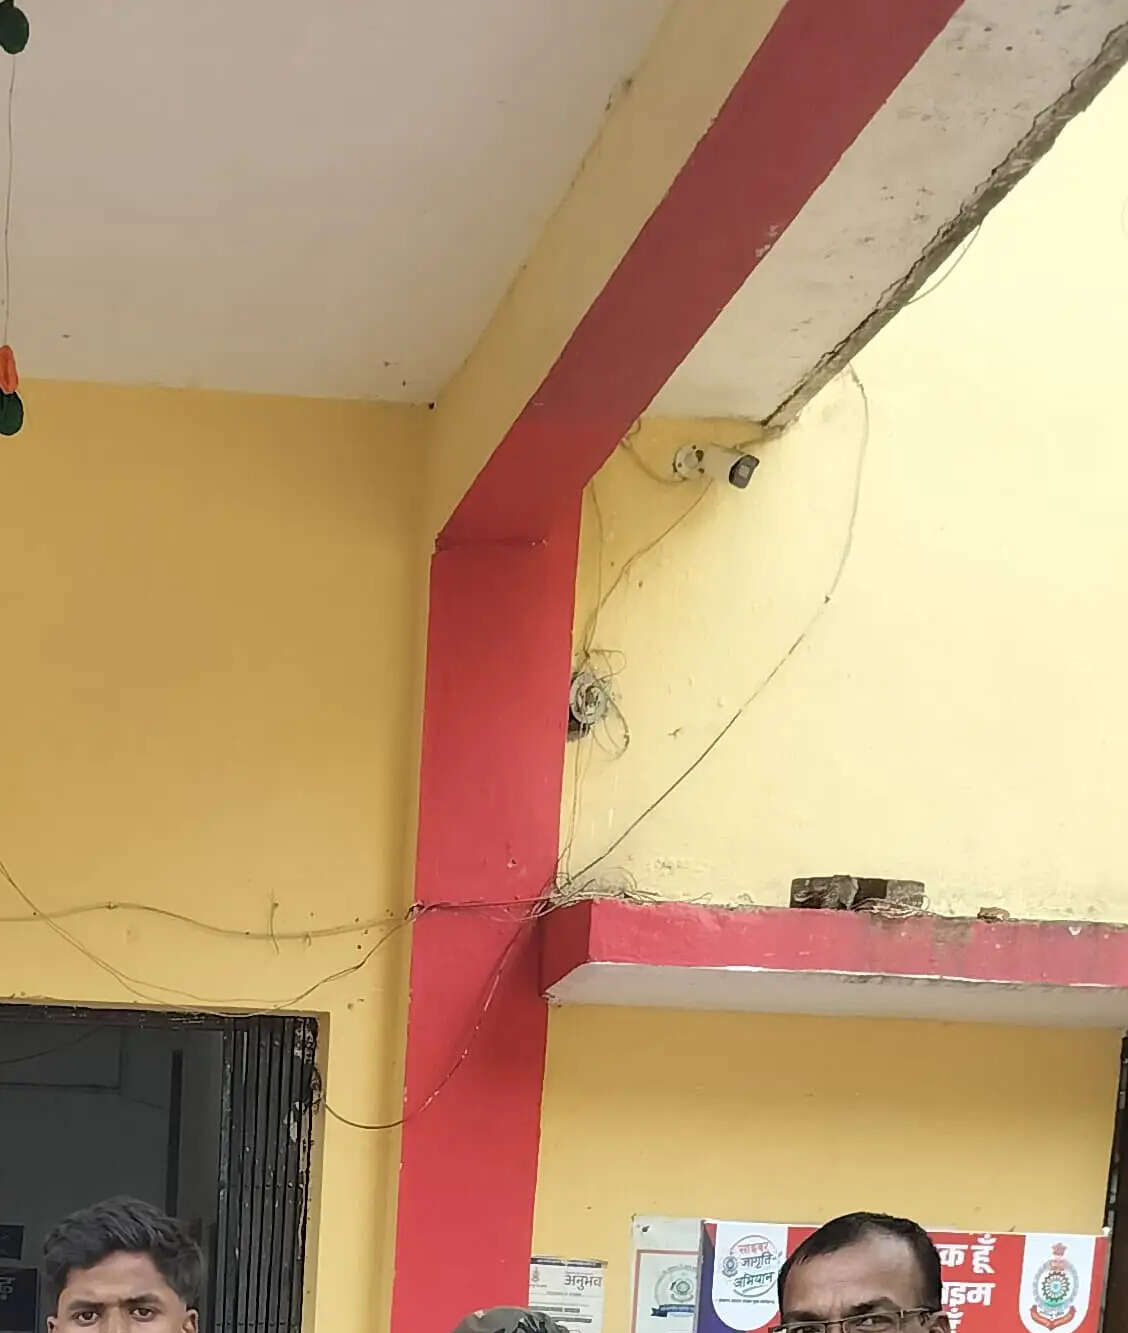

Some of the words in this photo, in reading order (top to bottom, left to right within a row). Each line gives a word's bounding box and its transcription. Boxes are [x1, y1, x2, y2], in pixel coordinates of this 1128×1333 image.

[935, 1243, 968, 1268] क
[970, 1234, 997, 1275] हूँ
[564, 1274, 603, 1291] अनुभव
